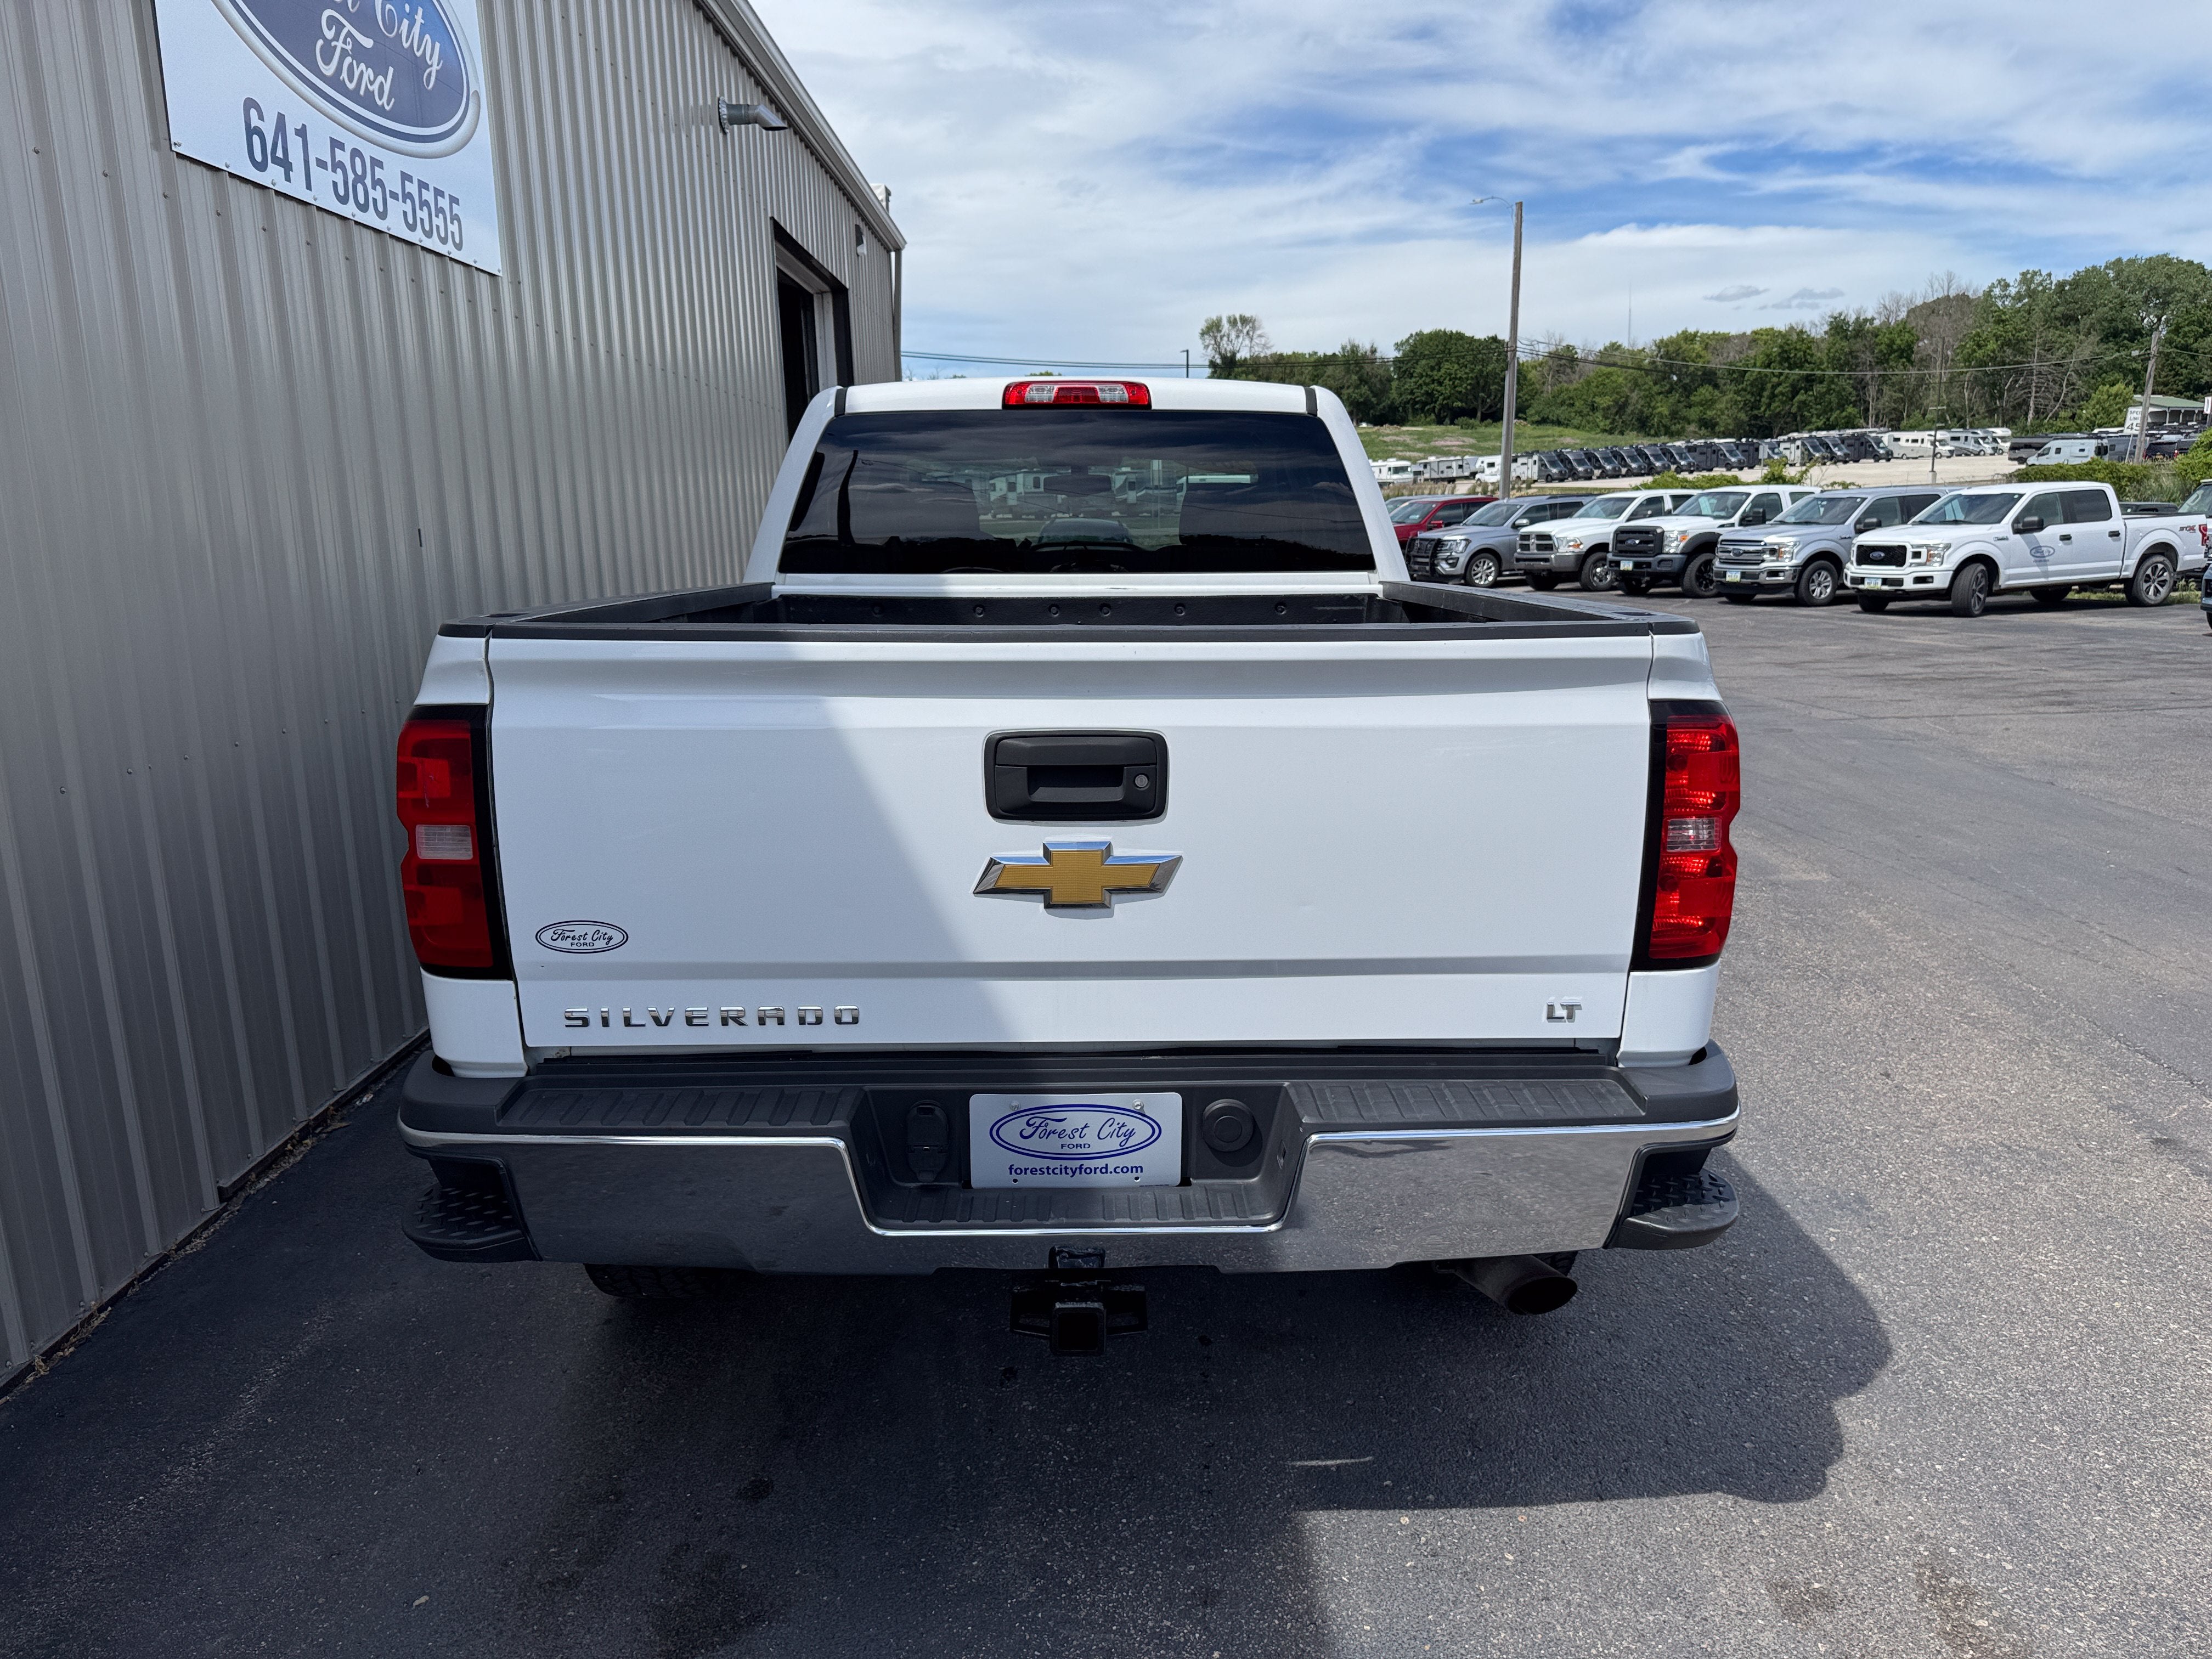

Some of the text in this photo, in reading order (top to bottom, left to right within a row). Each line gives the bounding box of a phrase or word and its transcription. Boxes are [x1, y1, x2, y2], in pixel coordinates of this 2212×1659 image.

[315, 9, 395, 110] Ford
[243, 97, 463, 251] 641-585-5555
[550, 929, 613, 945] Forest City
[564, 1005, 860, 1028] SILVERADO
[1546, 1001, 1582, 1023] LT
[1019, 1116, 1136, 1147] Forest City
[1008, 1163, 1143, 1178] forestcityford.com
